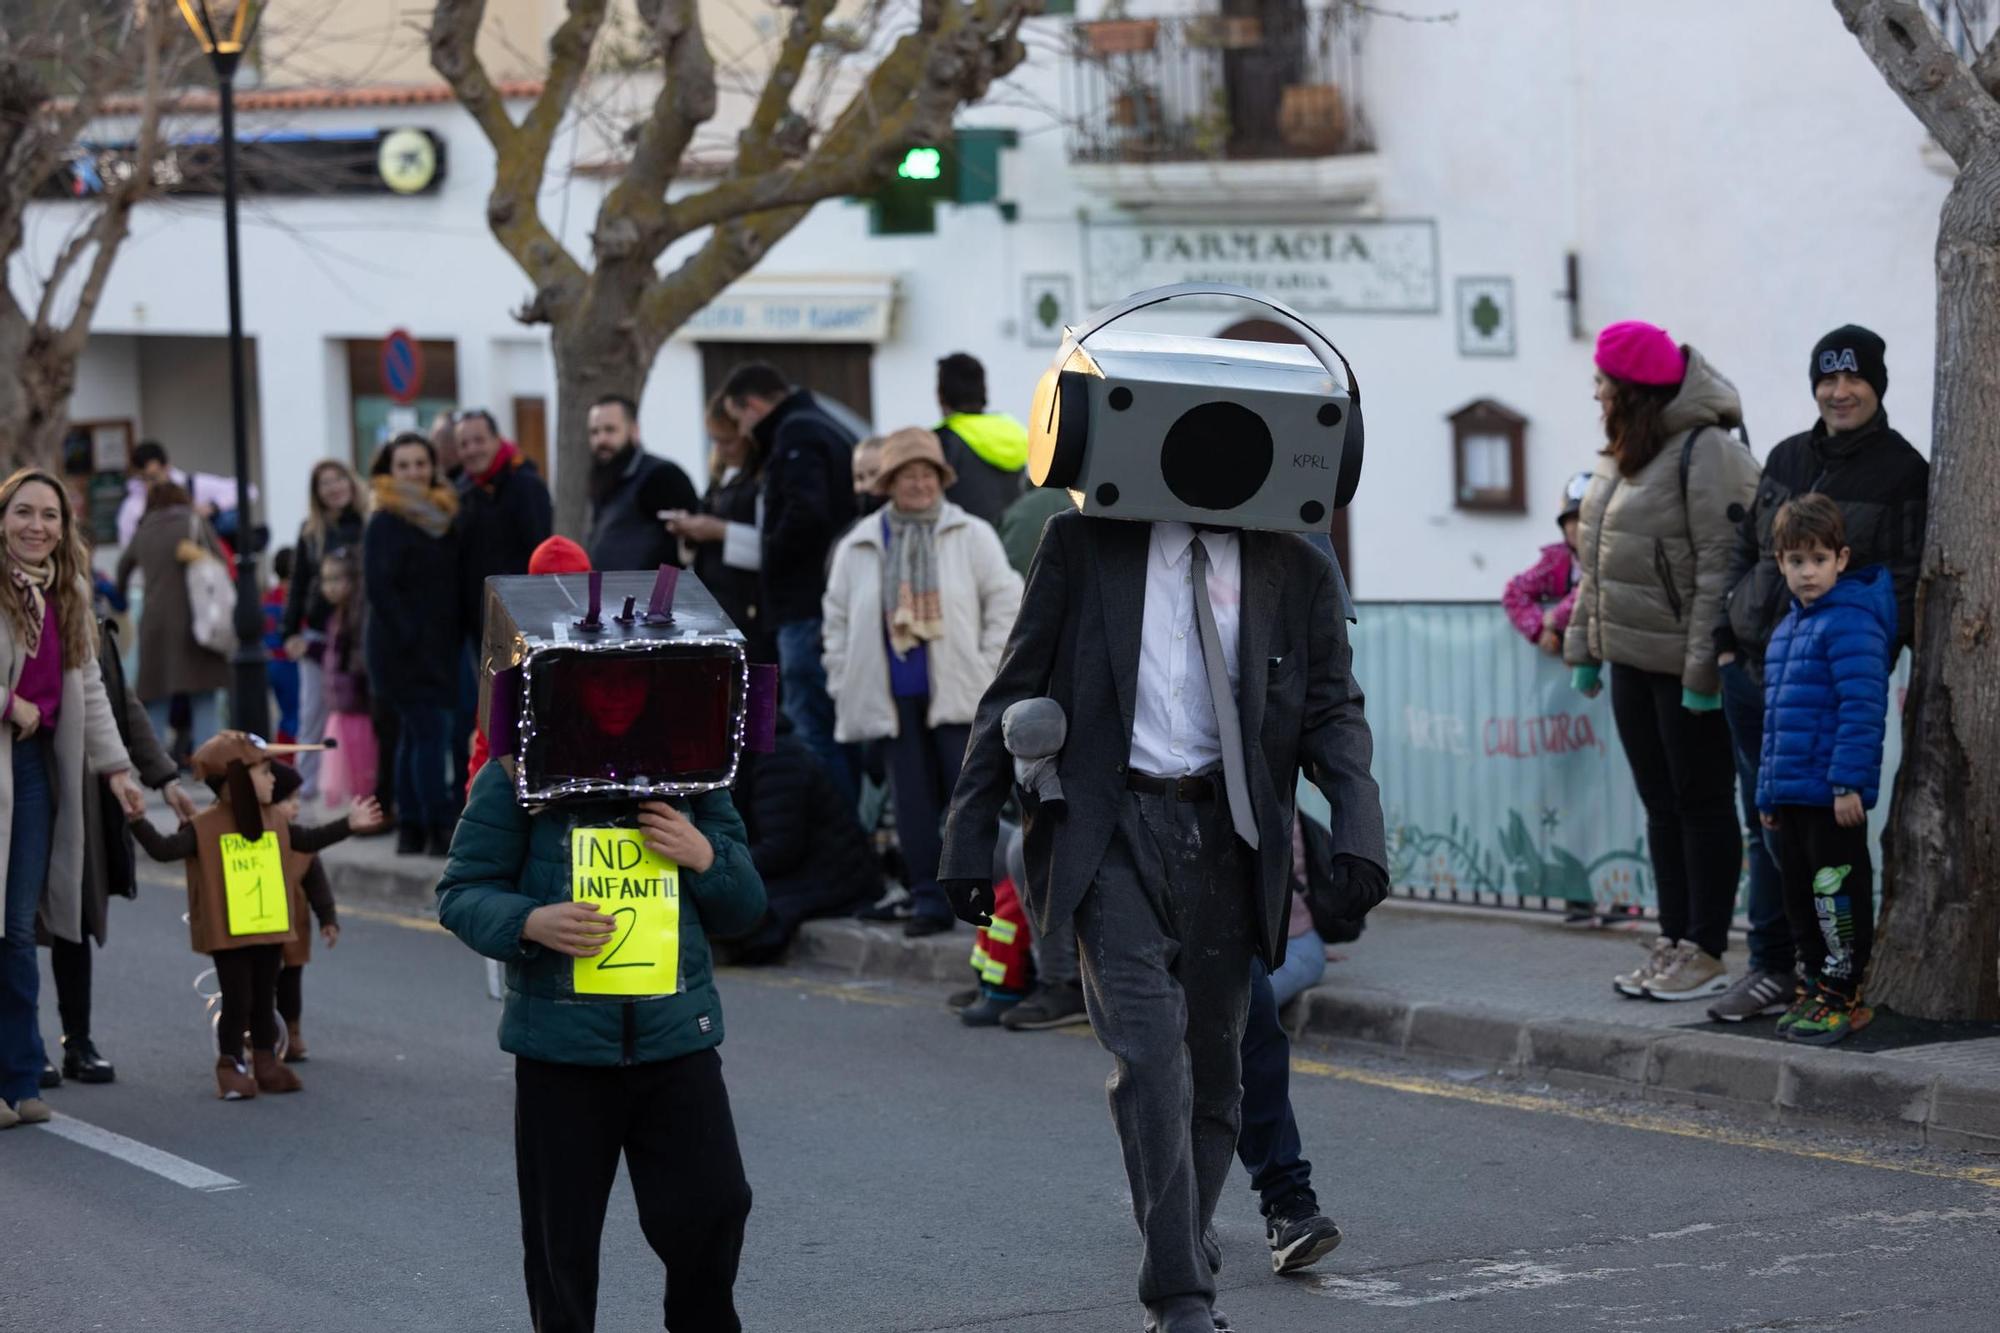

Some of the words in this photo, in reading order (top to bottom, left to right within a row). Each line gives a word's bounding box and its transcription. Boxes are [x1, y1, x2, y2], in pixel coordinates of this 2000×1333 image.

[1141, 232, 1369, 261] FARMACIA
[1292, 453, 1329, 470] KPRL
[578, 834, 650, 871] IND.
[244, 875, 274, 922] 1
[579, 875, 678, 900] INFANTIL
[596, 906, 656, 971] 2
